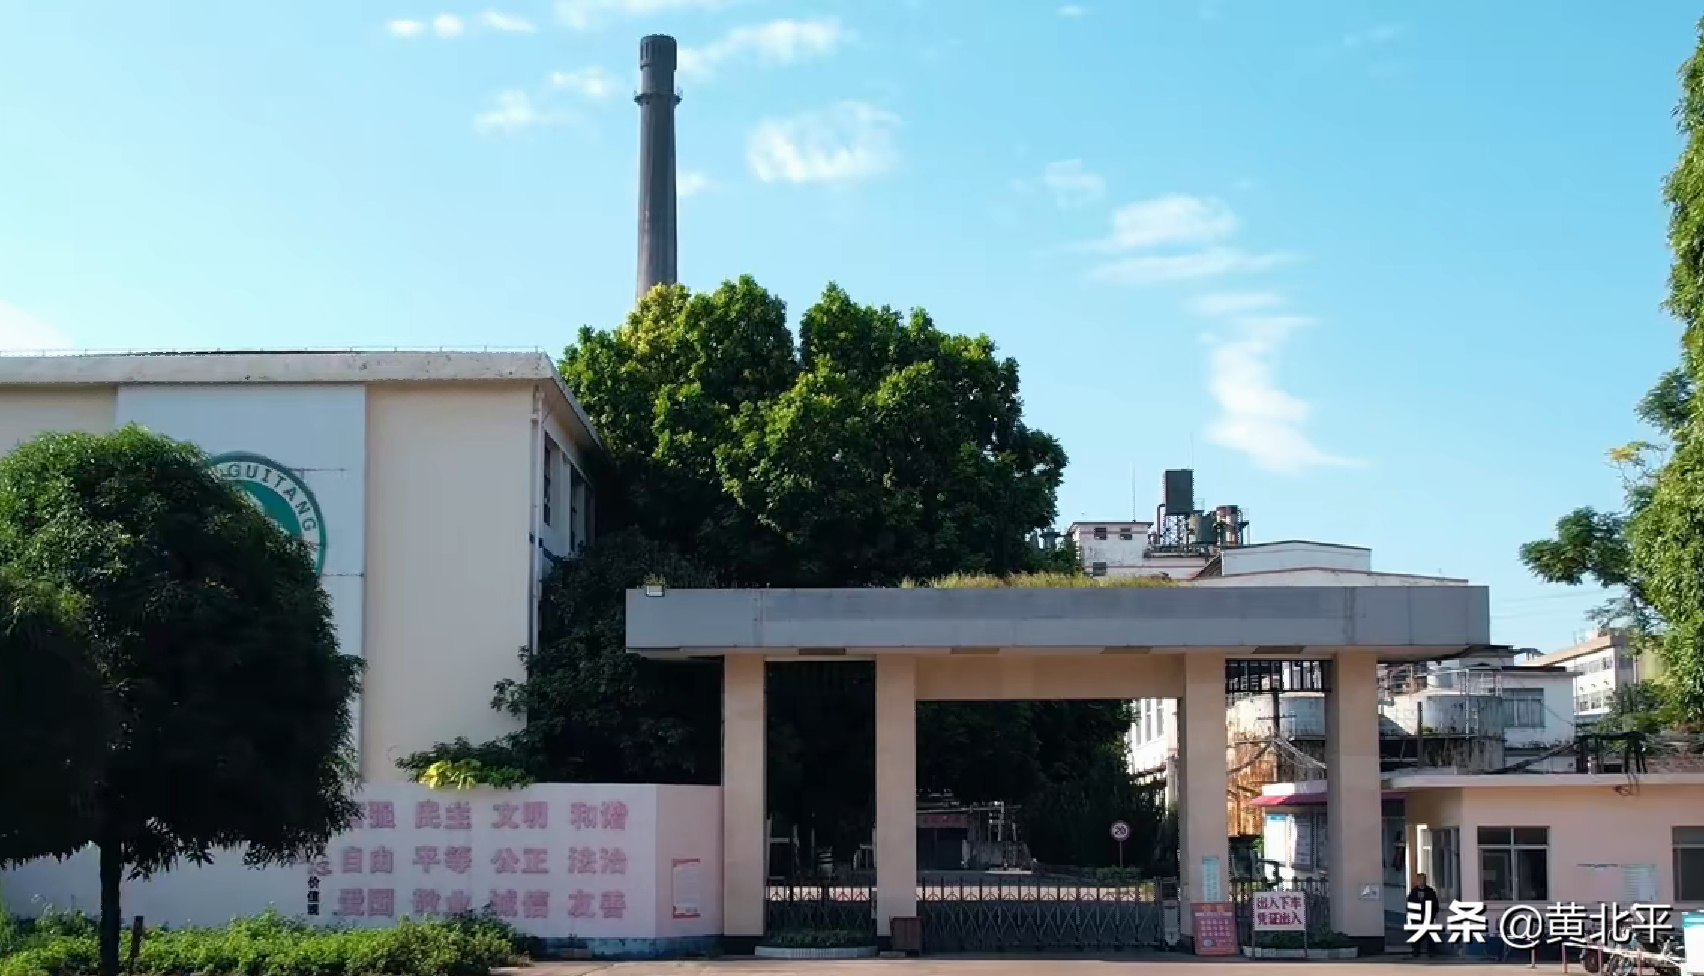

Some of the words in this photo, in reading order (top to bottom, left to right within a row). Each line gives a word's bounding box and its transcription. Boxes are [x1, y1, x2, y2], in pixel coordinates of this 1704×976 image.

[228, 464, 316, 531] GUITANG
[415, 799, 472, 829] 民主
[491, 801, 549, 829] 文明
[570, 801, 628, 830] 和谐
[1114, 825, 1127, 835] 20
[341, 846, 394, 874] 自由
[412, 846, 472, 874] 平等
[491, 847, 550, 874] 公正
[568, 846, 627, 874] 法治
[568, 889, 626, 919] 友善
[1257, 896, 1302, 910] 出入下车
[1257, 911, 1302, 926] 凭证出入
